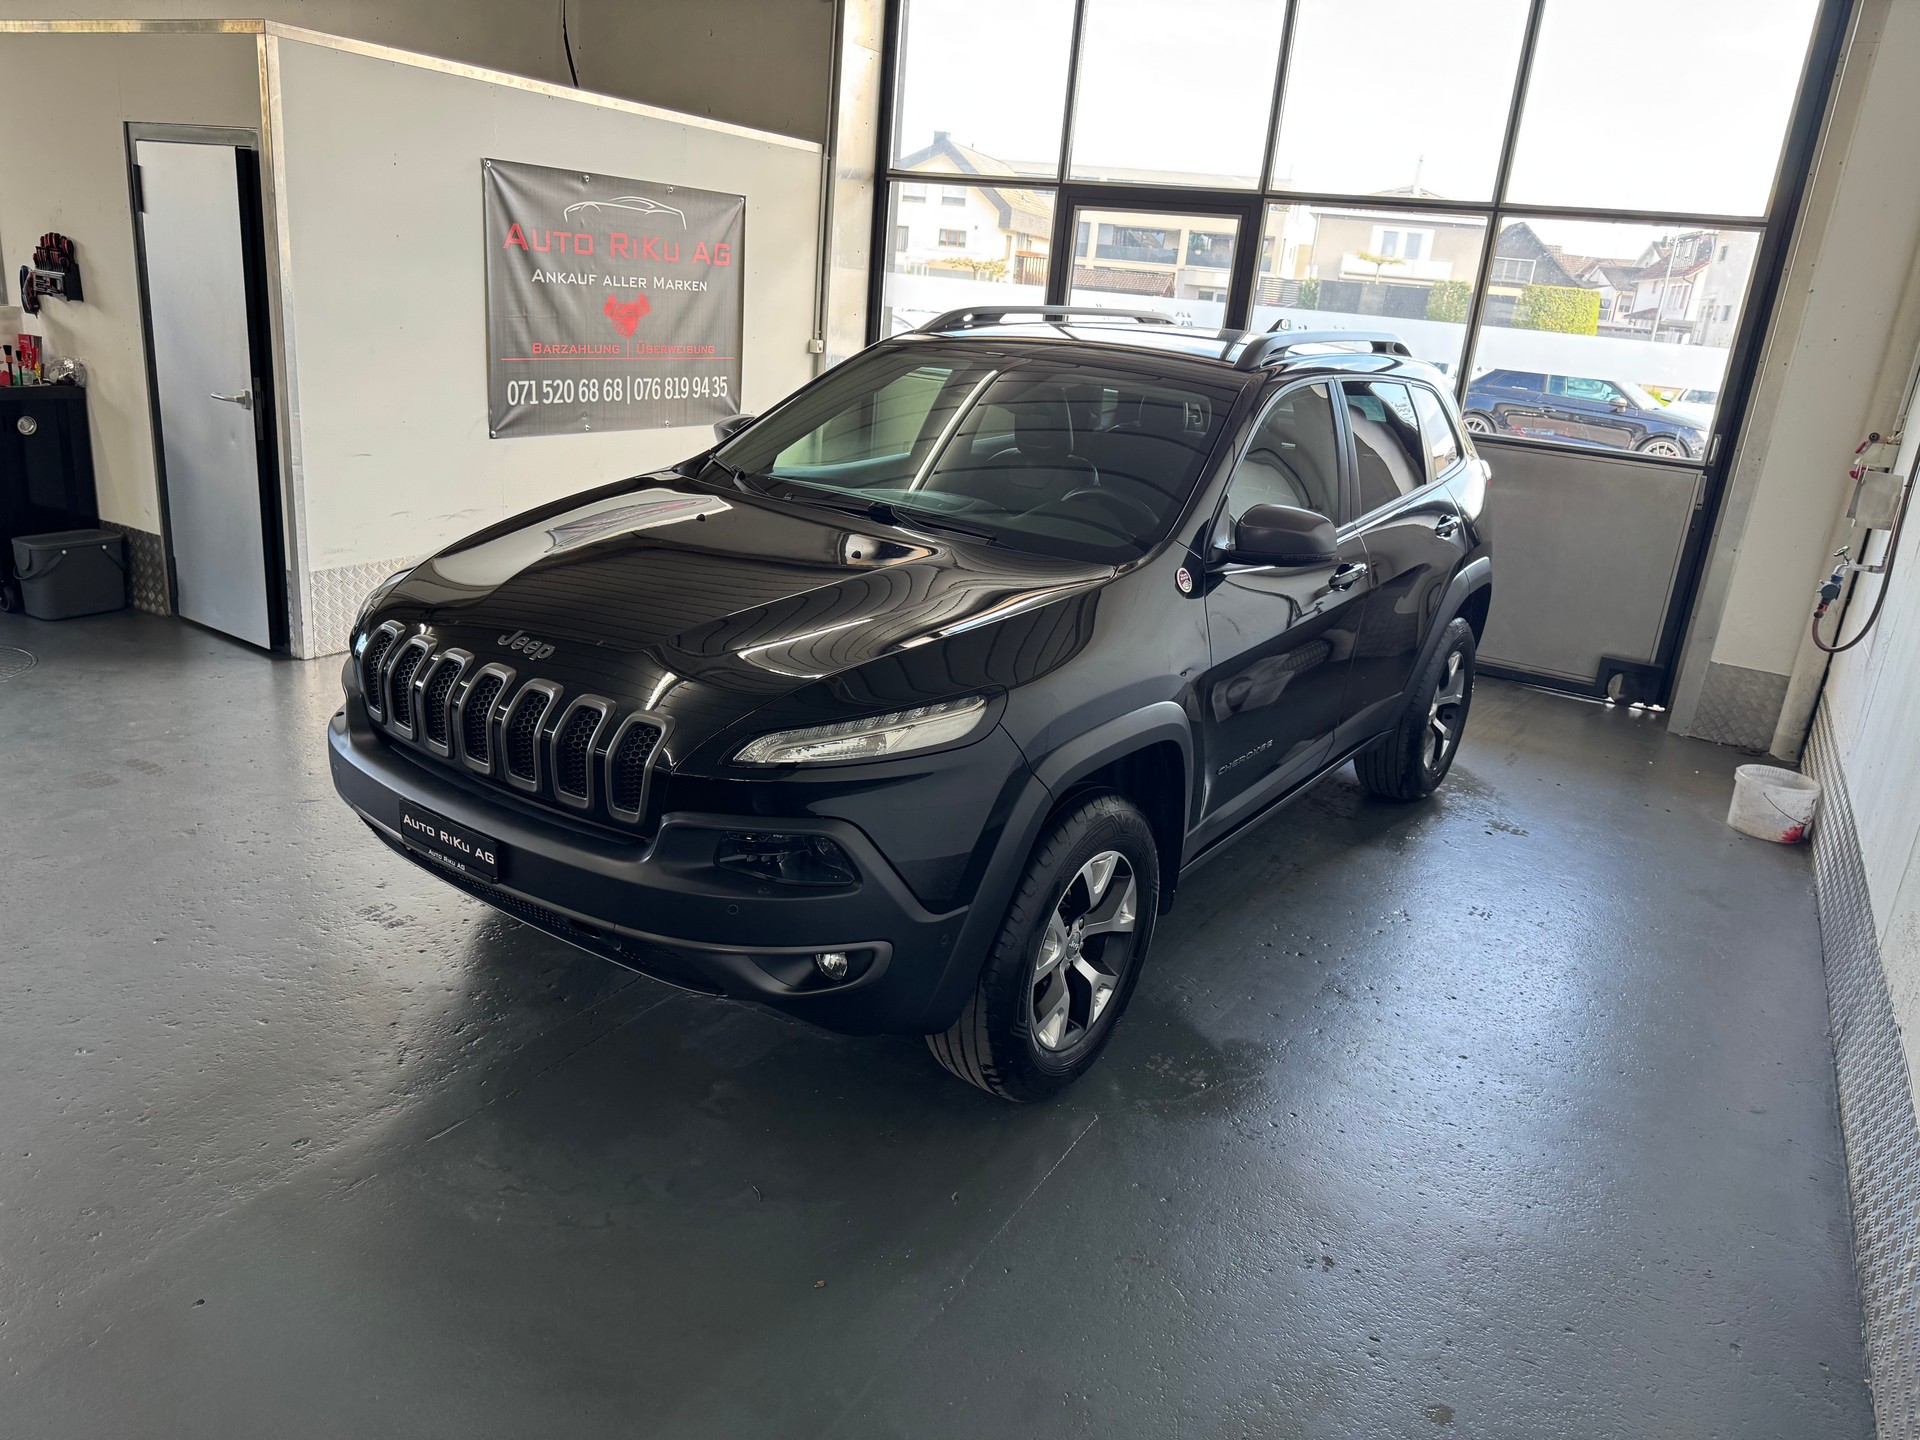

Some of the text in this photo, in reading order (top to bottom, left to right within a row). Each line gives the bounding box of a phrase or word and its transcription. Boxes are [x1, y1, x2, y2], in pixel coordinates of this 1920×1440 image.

[692, 241, 731, 266] AG
[507, 376, 728, 405] 071 520 68 68 076 819 94 35
[497, 629, 555, 660] Jeep
[457, 862, 466, 871] AG
[475, 847, 495, 865] AG
